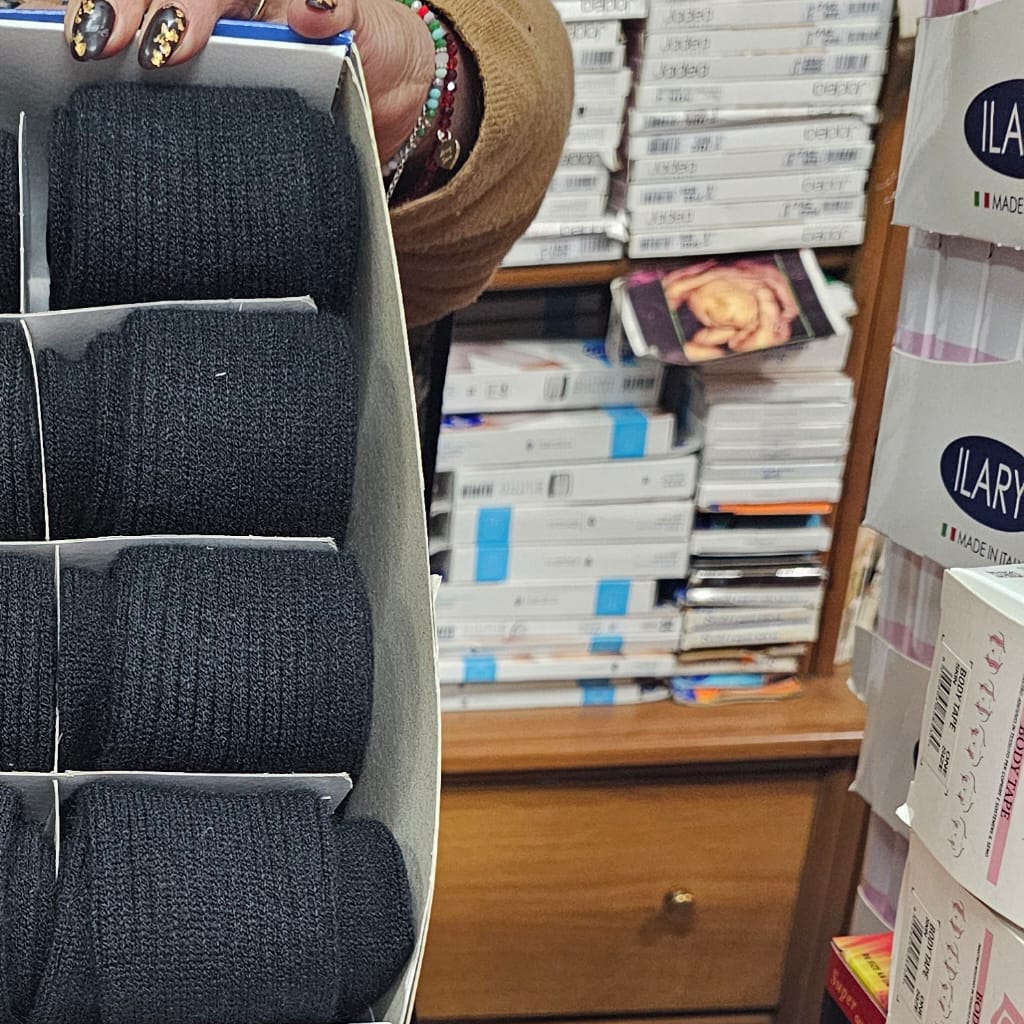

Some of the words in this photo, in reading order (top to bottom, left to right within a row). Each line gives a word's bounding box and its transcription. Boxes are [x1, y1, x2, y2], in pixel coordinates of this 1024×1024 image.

[992, 194, 1024, 214] MADE
[954, 446, 1024, 519] ILARY
[957, 531, 987, 557] MADE
[987, 545, 999, 563] IN
[953, 667, 967, 704] BODY
[949, 703, 962, 733] TAPE
[1008, 723, 1024, 774] BODY
[1000, 777, 1016, 821] TAPE
